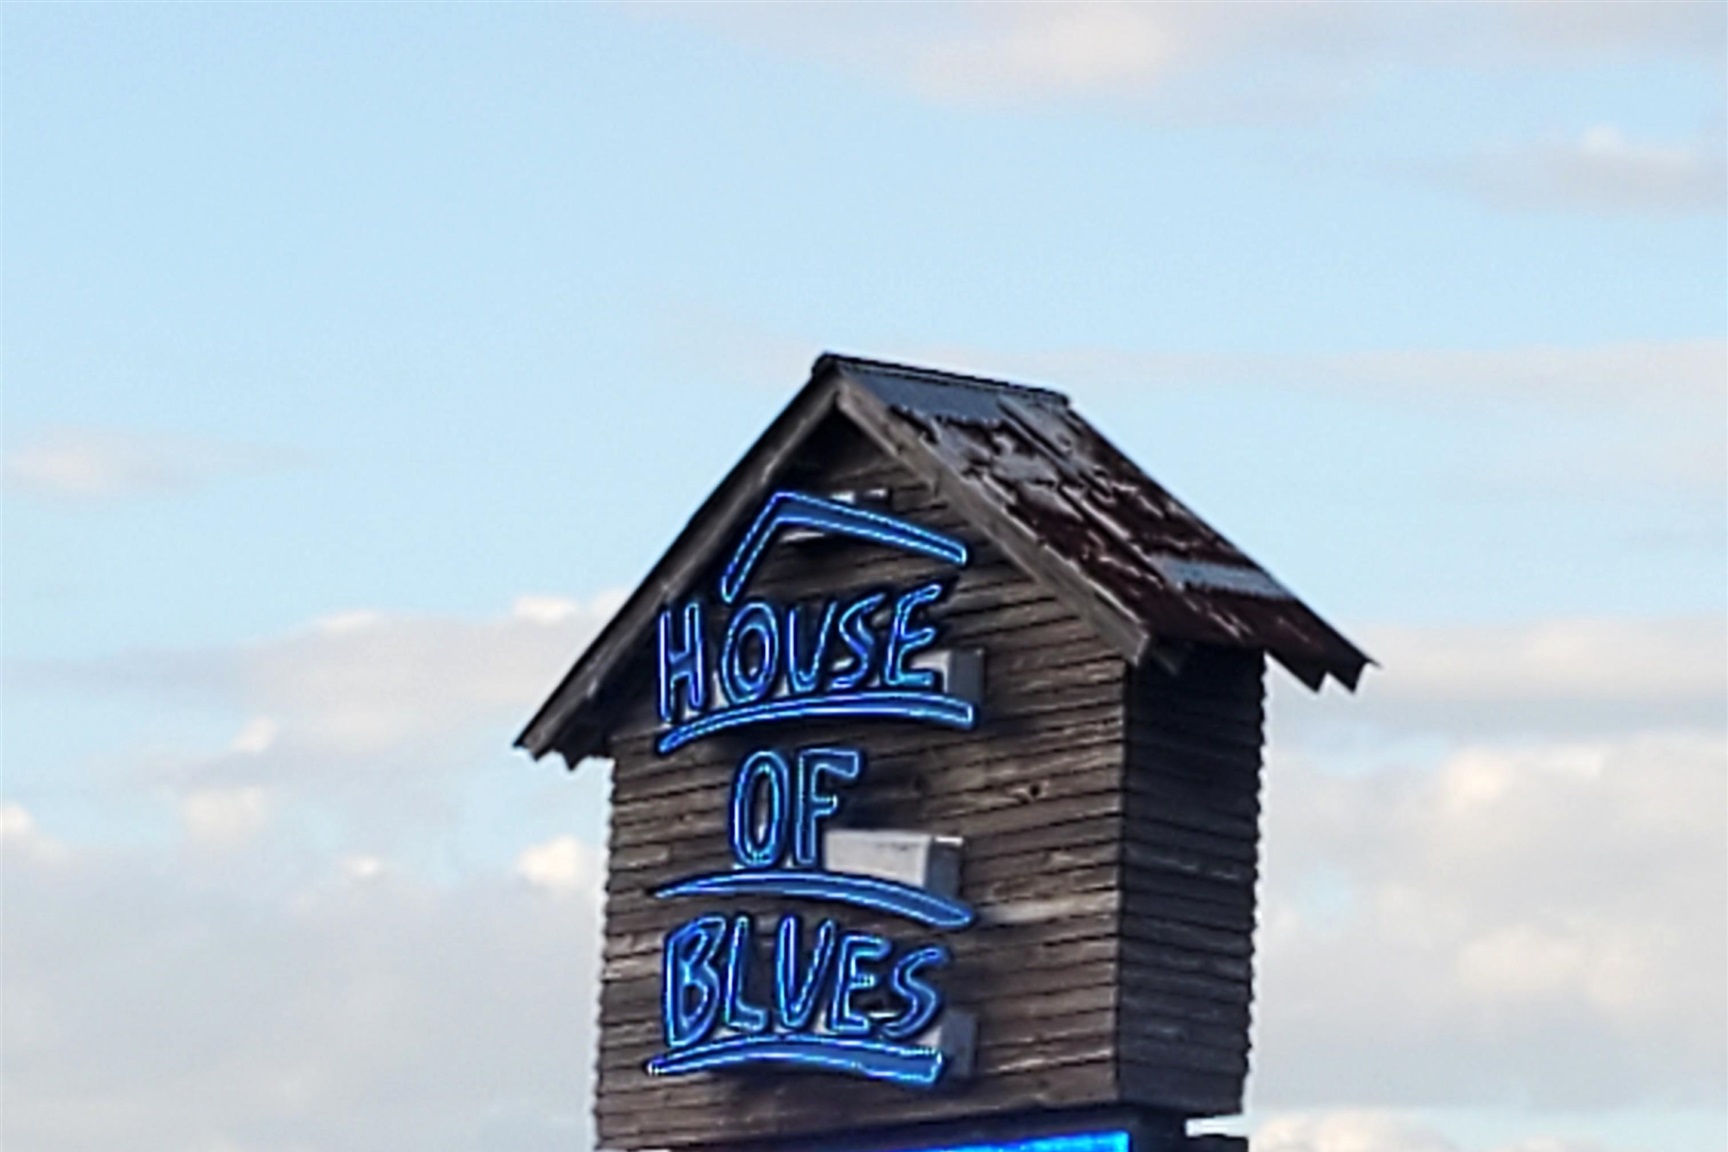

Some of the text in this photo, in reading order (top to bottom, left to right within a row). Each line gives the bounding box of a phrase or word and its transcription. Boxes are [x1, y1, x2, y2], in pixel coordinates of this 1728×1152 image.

[658, 583, 942, 724] HOUSE
[730, 749, 861, 869] OF
[664, 915, 948, 1048] BLUES
